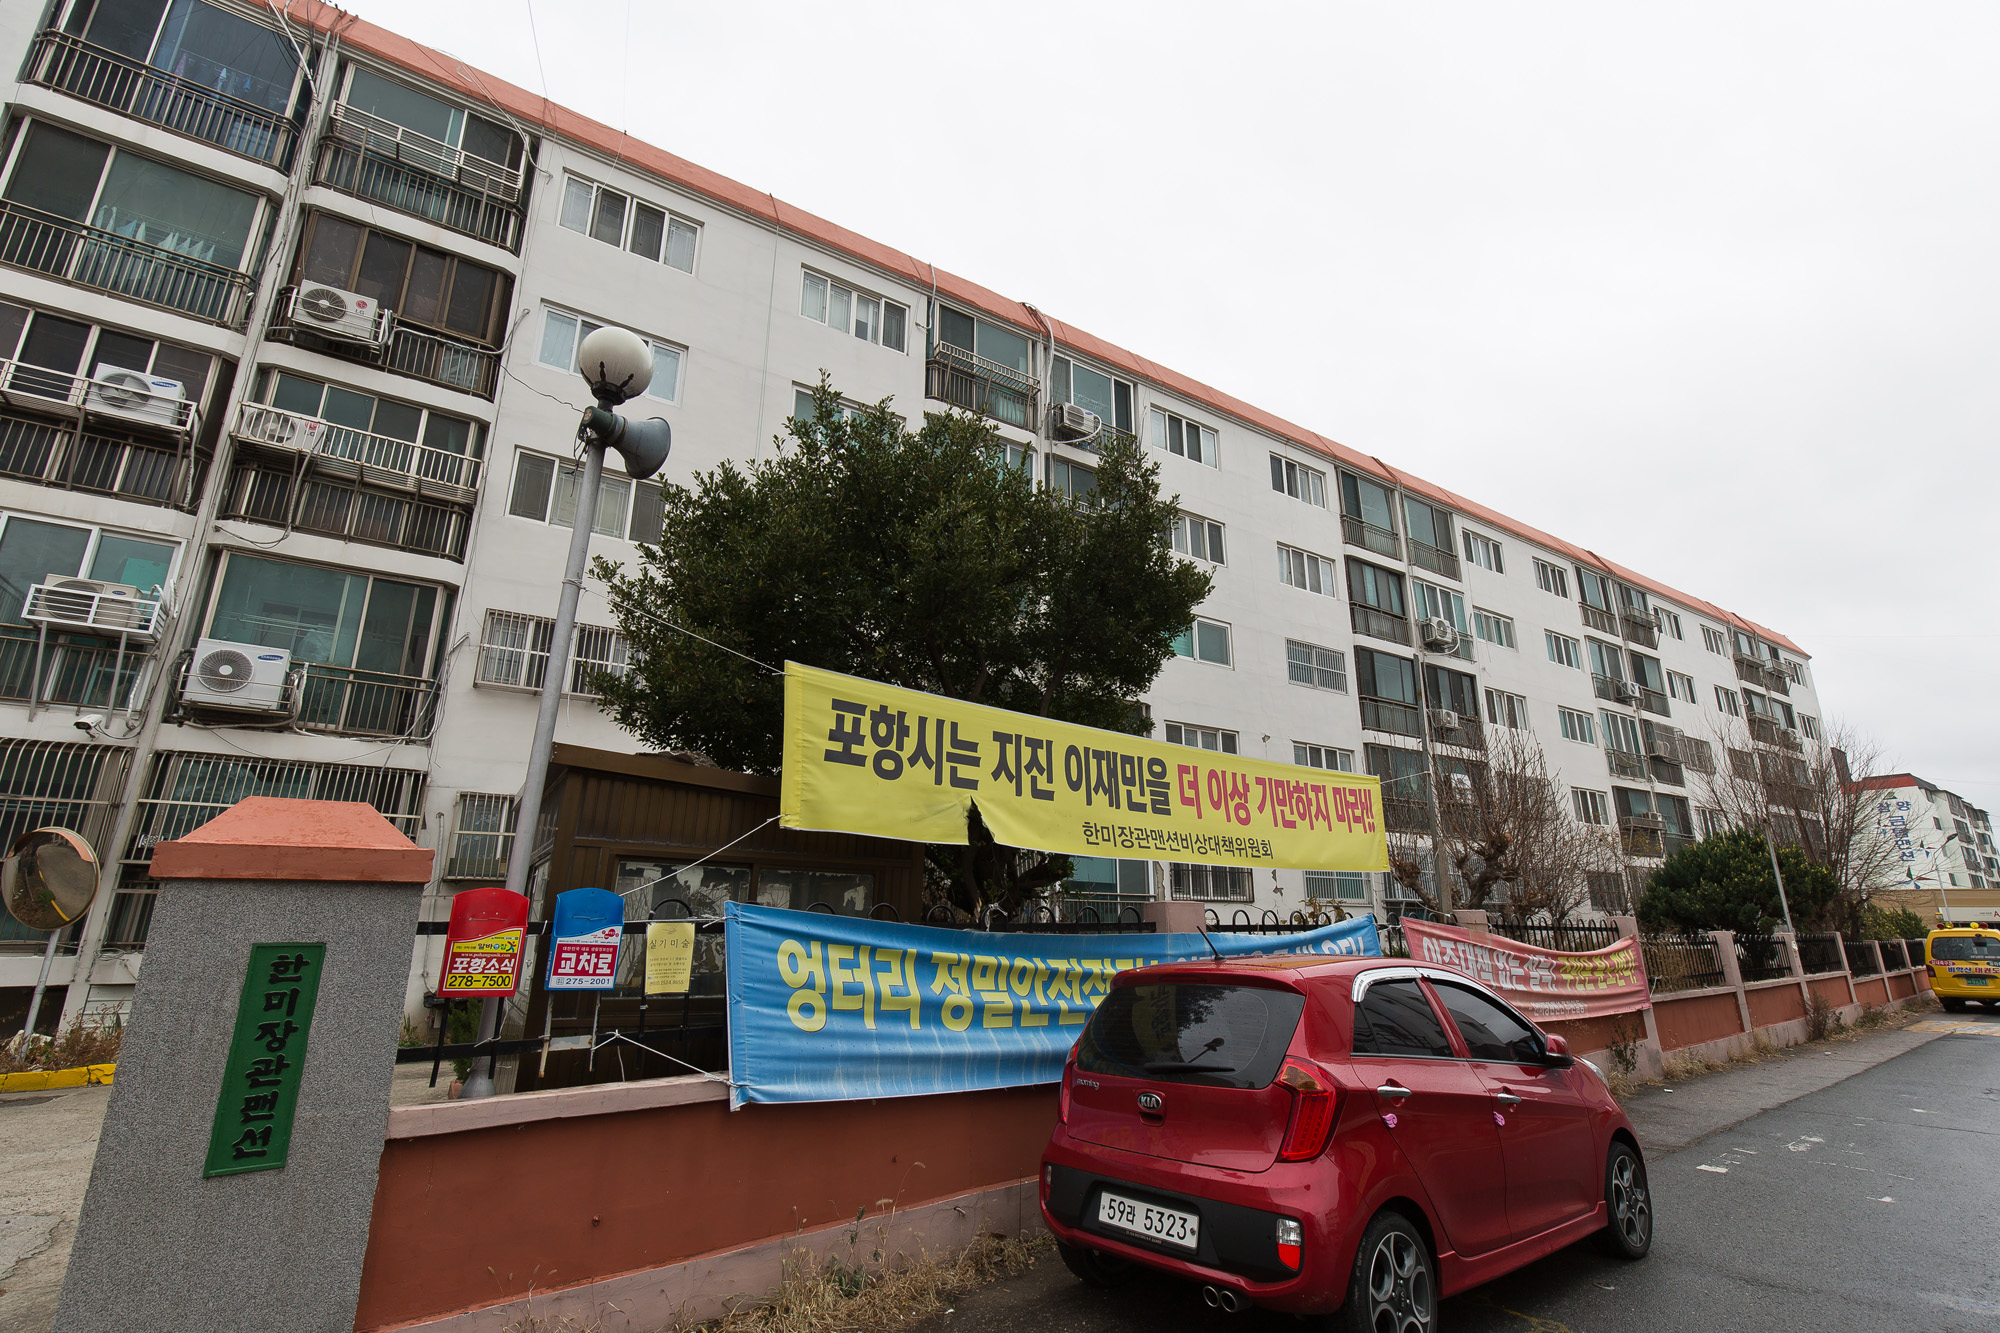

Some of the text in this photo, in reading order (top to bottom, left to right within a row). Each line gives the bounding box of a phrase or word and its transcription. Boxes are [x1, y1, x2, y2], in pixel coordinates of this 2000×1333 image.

[824, 698, 1376, 834] 포항시는 지진 이재민을 더 이상 기만하지 마라!!
[1082, 821, 1274, 860] 한미장관맨션비상대책위원회
[448, 975, 511, 987] 278-7500
[451, 957, 515, 974] 포항소식
[557, 952, 612, 974] 교차로
[565, 977, 610, 985] 275-2001
[1422, 937, 1496, 989] 이주대책
[1493, 949, 1527, 991] 없는
[777, 938, 1158, 1033] 엉터리 정밀안전점
[231, 952, 310, 1160] 한미장관맨션
[1107, 1198, 1136, 1226] 59라
[1144, 1207, 1188, 1241] 5323
